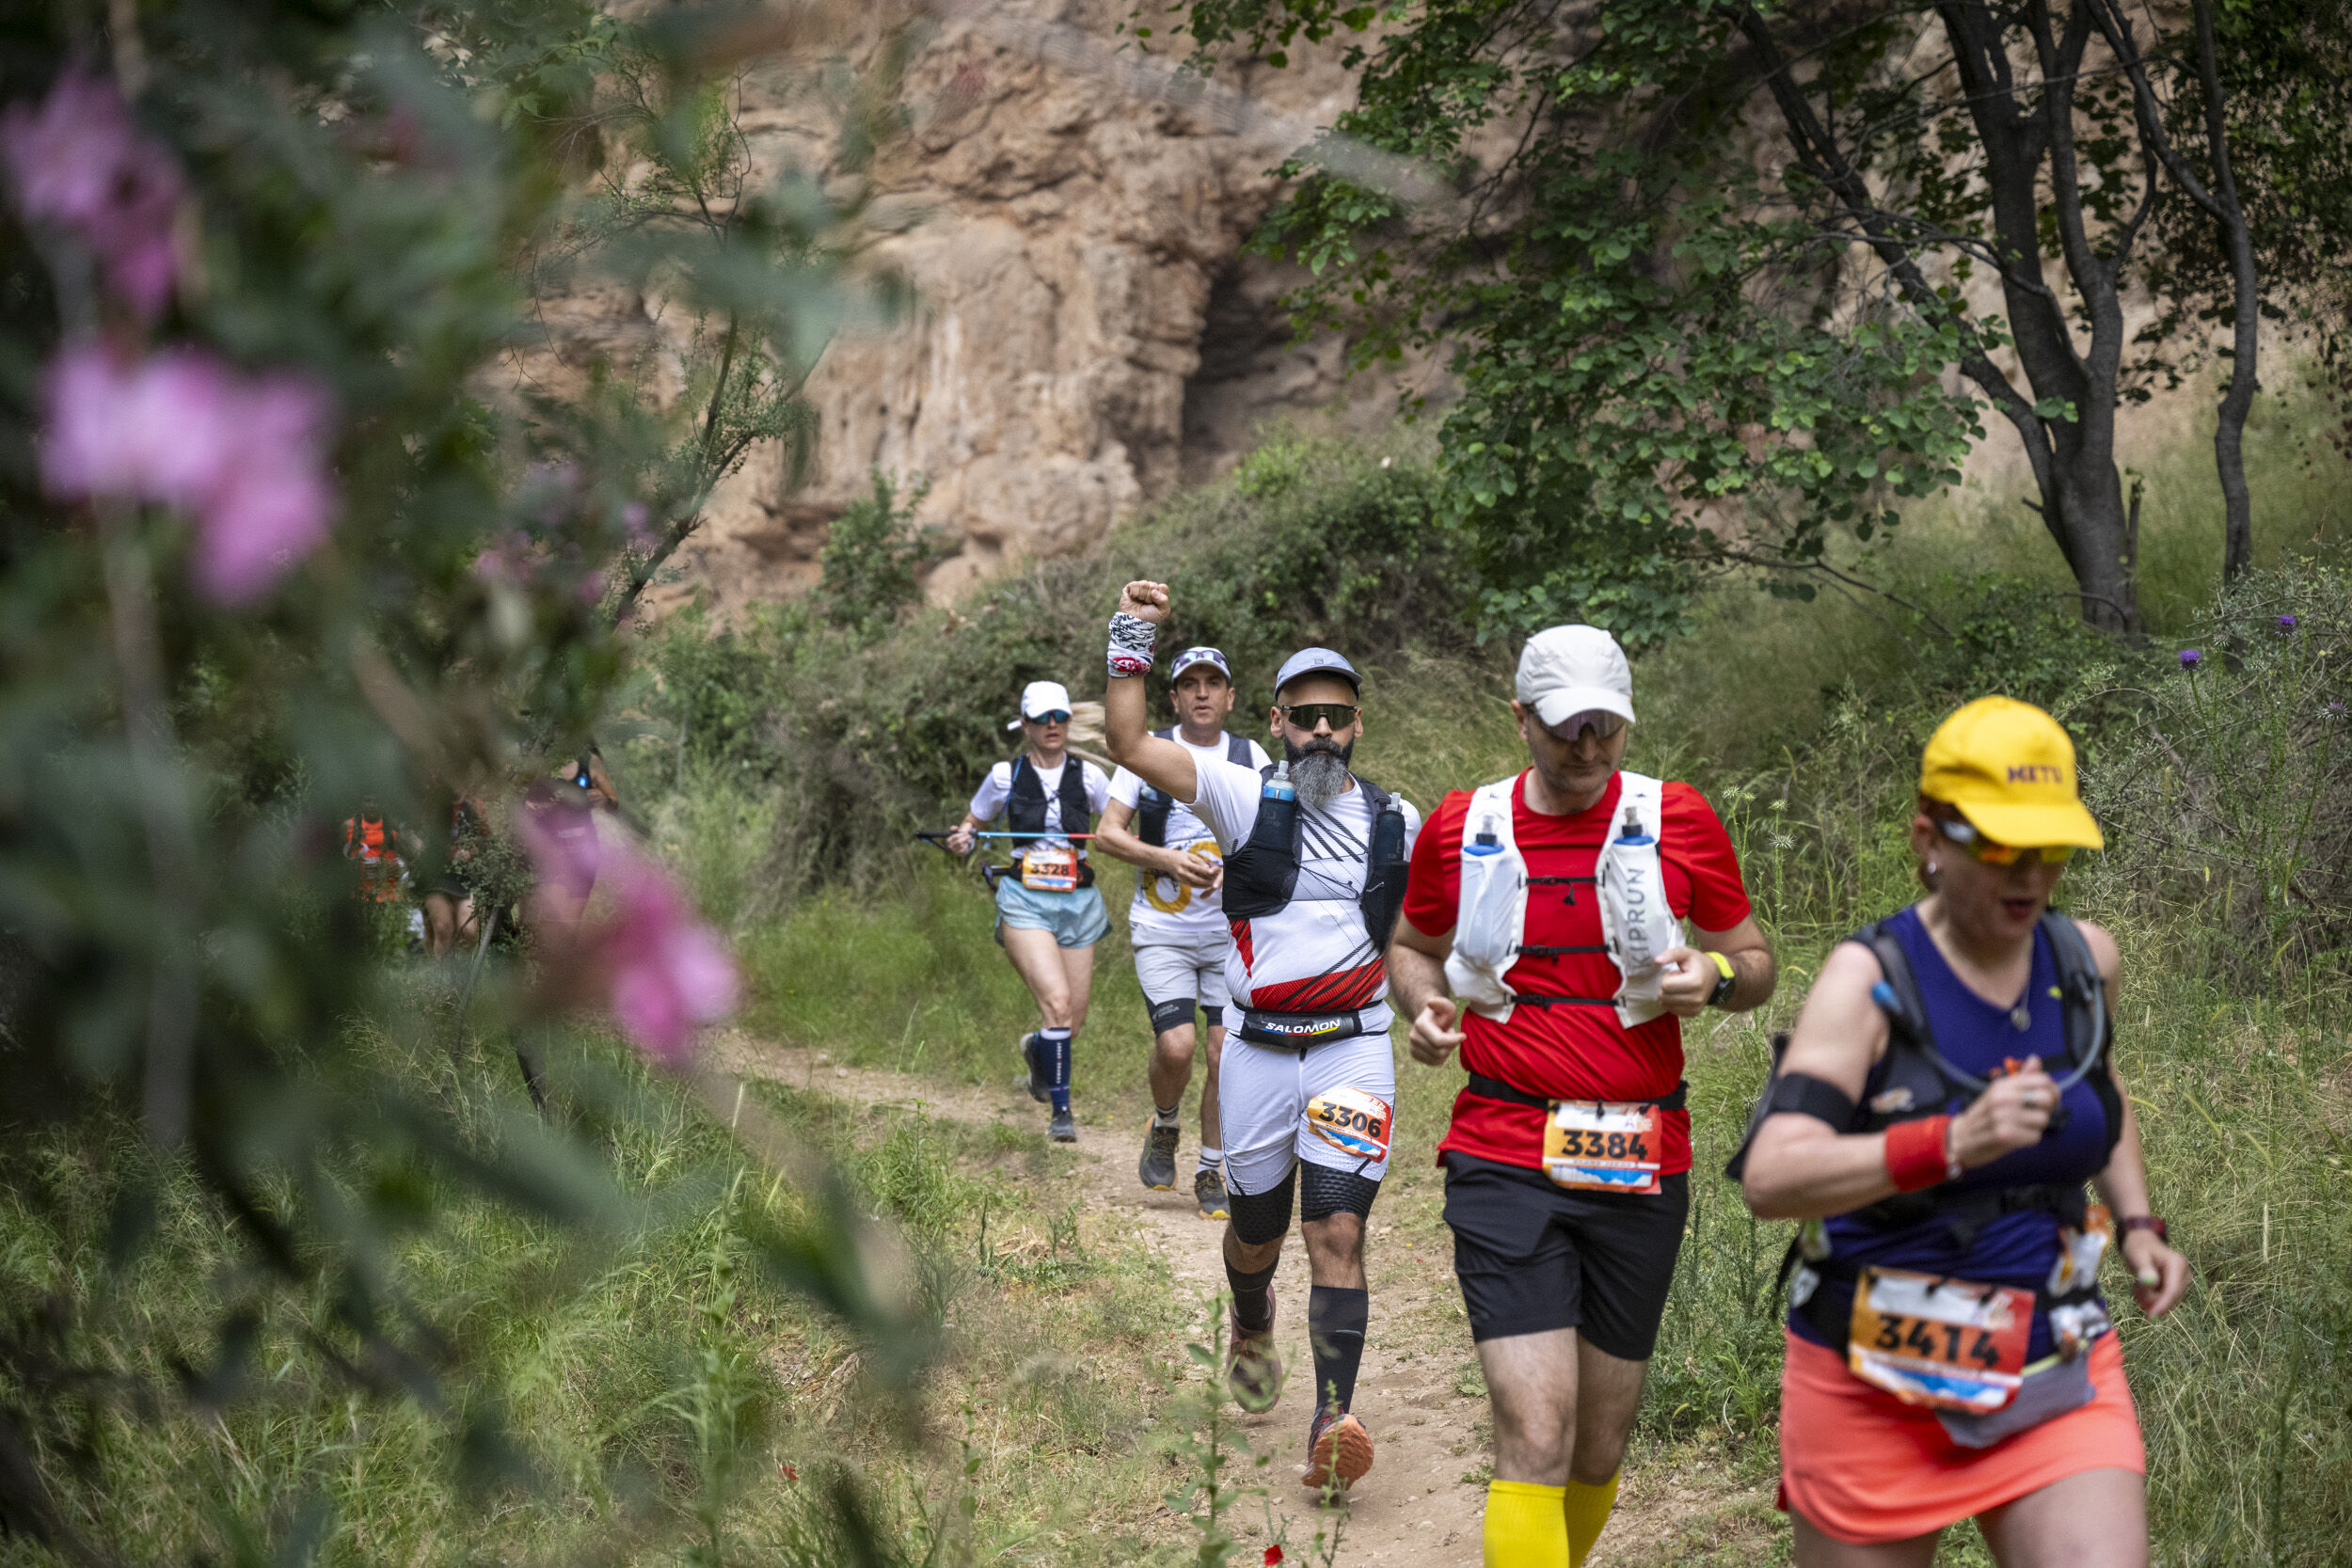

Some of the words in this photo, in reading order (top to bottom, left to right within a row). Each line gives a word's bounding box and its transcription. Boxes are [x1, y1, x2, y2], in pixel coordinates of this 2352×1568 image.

[1030, 863, 1069, 876] 3328
[1626, 867, 1650, 973] KIPRUN
[1264, 1019, 1341, 1034] SALOMON
[1318, 1101, 1383, 1139] 3306
[1561, 1130, 1647, 1161] 3384
[1875, 1314, 2000, 1369] 3414
